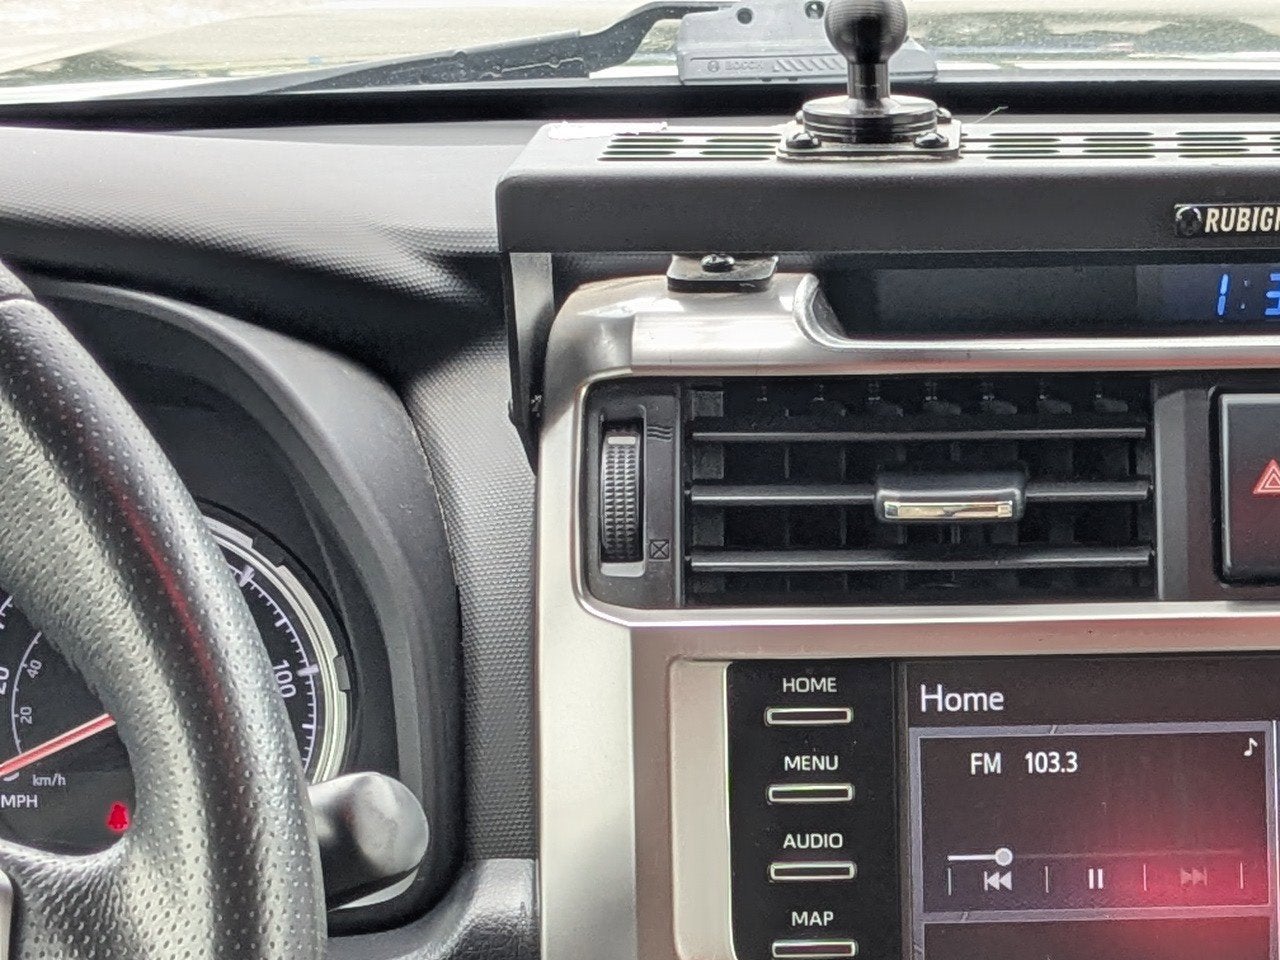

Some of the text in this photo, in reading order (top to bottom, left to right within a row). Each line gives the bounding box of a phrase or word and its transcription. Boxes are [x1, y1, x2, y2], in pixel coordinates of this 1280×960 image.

[27, 660, 42, 679] 40
[272, 658, 297, 699] 100
[782, 677, 838, 694] HOME
[920, 683, 1005, 713] Home
[20, 706, 33, 725] 20
[783, 755, 839, 771] MENU
[970, 751, 1079, 775] FM 103.3
[32, 772, 67, 787] km/h
[0, 794, 38, 808] MPH
[782, 833, 844, 849] AUDIO
[791, 910, 834, 926] MAP
